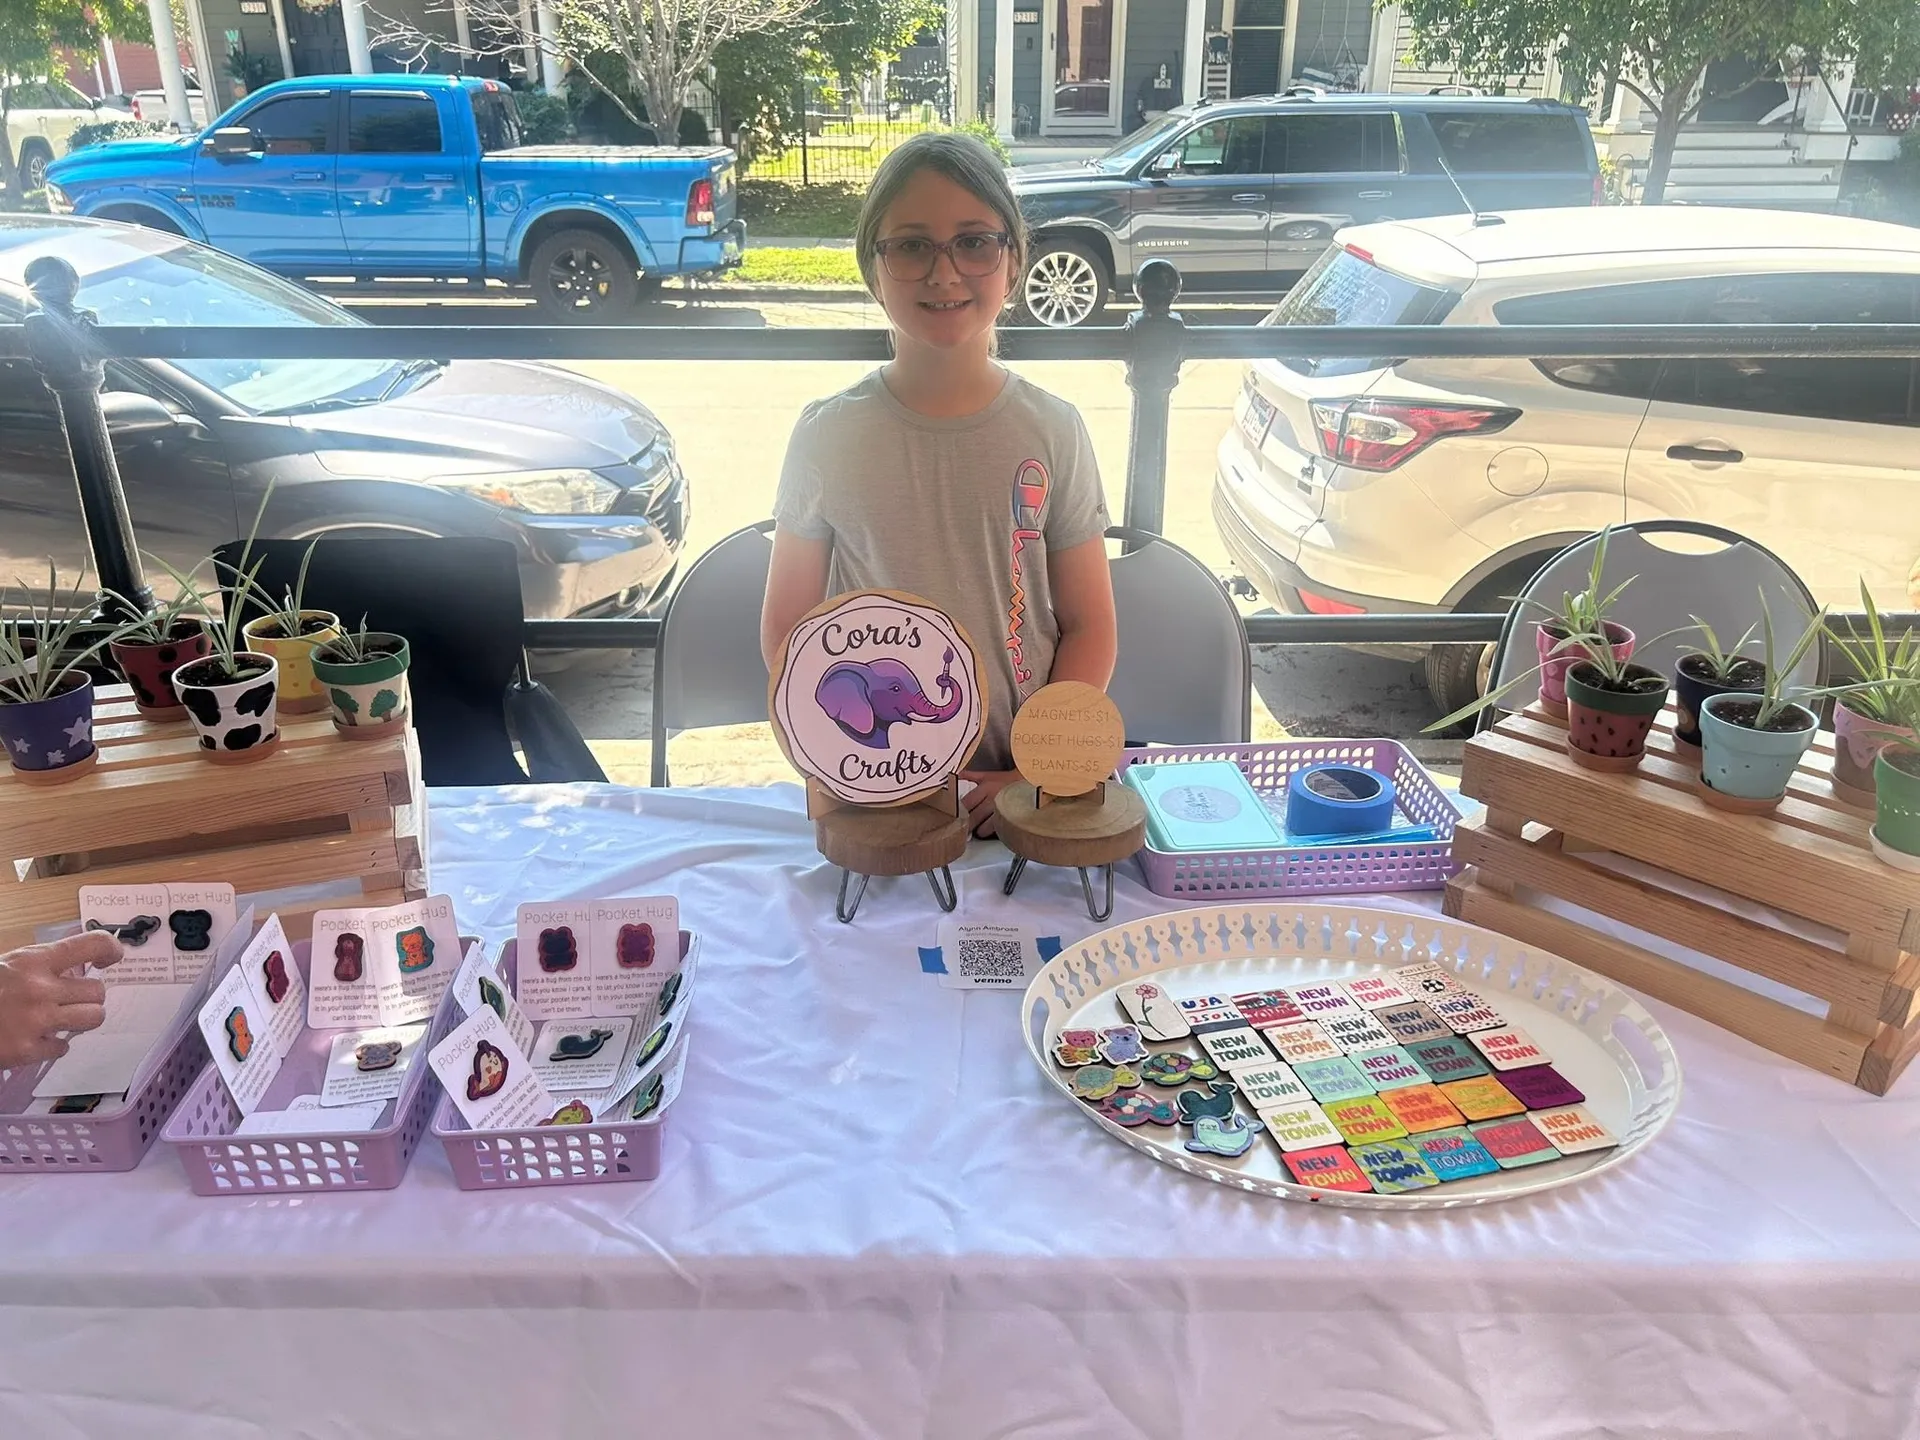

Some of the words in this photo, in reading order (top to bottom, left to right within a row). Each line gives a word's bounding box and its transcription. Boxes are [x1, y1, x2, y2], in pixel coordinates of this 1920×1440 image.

[822, 617, 922, 656] Cora's
[1028, 708, 1109, 723] MAGNETS-$1
[1014, 733, 1062, 745] POCKET
[839, 749, 936, 785] Crafts
[1032, 758, 1100, 772] PLANTS-$5
[86, 894, 130, 906] Pocket
[136, 893, 163, 908] Hug
[205, 891, 232, 904] Hug
[372, 913, 416, 932] Pocket
[420, 904, 448, 920] Hug
[524, 910, 568, 924] Pocket
[574, 910, 590, 921] Hu
[596, 908, 642, 921] Pocket
[646, 906, 674, 920] Hug
[244, 942, 268, 974] Pocket
[266, 924, 280, 944] Hug
[458, 967, 477, 1004] Pocket
[473, 952, 485, 974] Hug
[1349, 978, 1385, 992] NEW
[1296, 987, 1332, 1000] NEW
[1355, 988, 1403, 1004] TOWN
[204, 993, 230, 1032] Pocket
[228, 975, 244, 995] Hug
[1181, 996, 1223, 1010] USA
[1300, 997, 1350, 1012] TOWN
[1439, 999, 1476, 1014] NEW
[1190, 1011, 1239, 1024] 250th
[1330, 1018, 1368, 1033] NEW
[1387, 1010, 1423, 1024] NEW
[1446, 1008, 1495, 1026] TOWN
[1276, 1029, 1314, 1044] NEW
[1392, 1020, 1441, 1036] TOWN
[437, 1036, 474, 1070] Pocket
[475, 1014, 498, 1039] Hug
[1210, 1035, 1248, 1050] NEW
[1336, 1030, 1386, 1046] TOWN
[1481, 1034, 1519, 1049] NEW
[1214, 1046, 1265, 1062] TOWN
[1282, 1040, 1332, 1057] TOWN
[1419, 1045, 1456, 1060] NEW
[1488, 1045, 1540, 1062] TOWN
[1363, 1054, 1400, 1070] NEW
[1425, 1056, 1476, 1073] TOWN
[1242, 1070, 1282, 1086] NEW
[1304, 1065, 1346, 1082] NEW
[1368, 1065, 1419, 1082] TOWN
[1247, 1082, 1300, 1100] TOWN
[1312, 1076, 1364, 1096] TOWN
[1394, 1092, 1433, 1110] NEW
[1270, 1109, 1312, 1126] NEW
[1336, 1104, 1376, 1122] NEW
[1400, 1104, 1454, 1124] TOWN
[1540, 1112, 1582, 1130] NEW
[1276, 1122, 1332, 1142] TOWN
[1340, 1116, 1396, 1136] TOWN
[1483, 1126, 1523, 1142] NEW
[1548, 1124, 1605, 1145] TOWN
[1424, 1136, 1465, 1154] NEW
[1490, 1138, 1546, 1158] TOWN
[1297, 1155, 1338, 1172] NEW
[1362, 1149, 1405, 1168] NEW
[1431, 1148, 1486, 1170] TOWN
[1302, 1169, 1358, 1188] TOWN
[1369, 1162, 1426, 1183] TOWN
